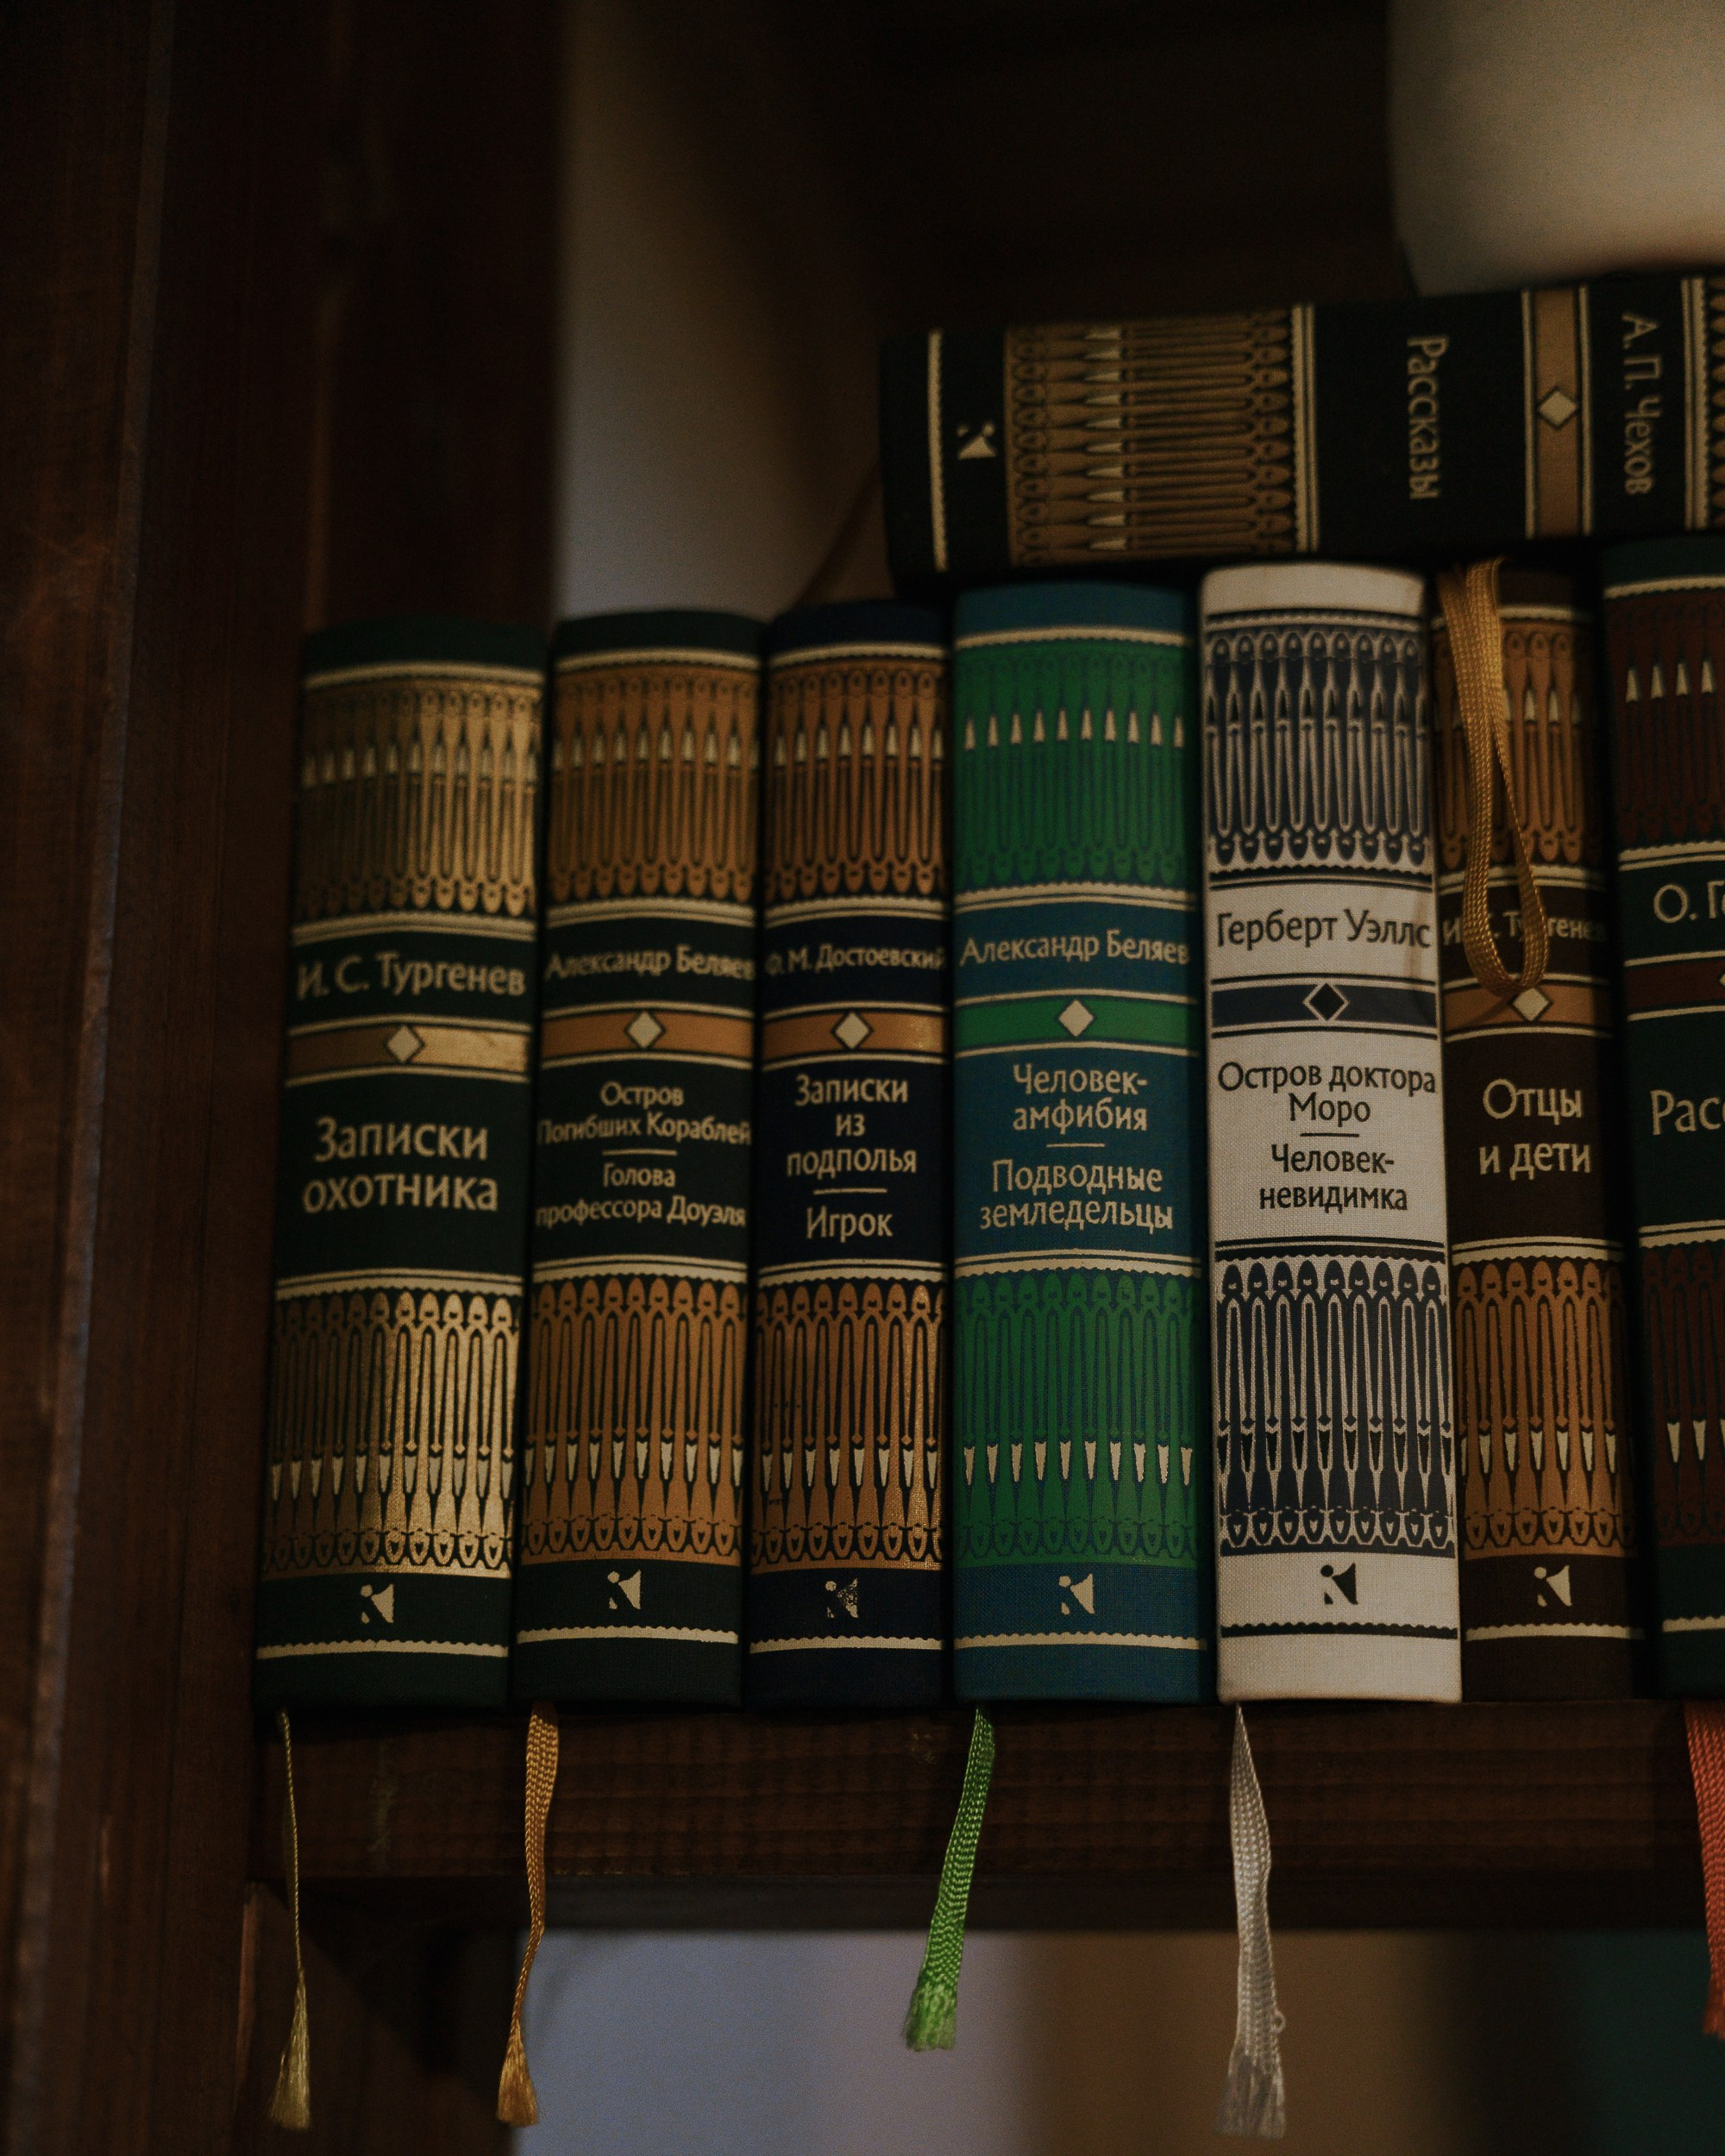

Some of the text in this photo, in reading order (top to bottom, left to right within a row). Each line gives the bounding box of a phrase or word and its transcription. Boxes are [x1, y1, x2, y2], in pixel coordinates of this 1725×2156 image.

[1406, 334, 1450, 500] Рассказы
[1622, 311, 1663, 496] А. П. Чехов
[1653, 881, 1725, 923] О. Г
[1217, 908, 1432, 950] Герберт Уэллс
[543, 943, 756, 981] Александр Беляев
[814, 943, 946, 974] Достоевский
[959, 929, 1191, 968] Александр Беляев
[297, 950, 527, 1000] И. С. Тургенев
[599, 1081, 684, 1109] Остров
[794, 1073, 909, 1107] Записки
[1013, 1063, 1149, 1096] Человек-
[1217, 1062, 1436, 1094] Остров доктора
[1013, 1097, 1148, 1134] амфибия
[1289, 1092, 1371, 1127] Моро
[1482, 1077, 1583, 1125] Отцы
[1649, 1089, 1725, 1136] Рас
[313, 1115, 488, 1163] Записки
[536, 1111, 751, 1146] Погибших Кораблей
[835, 1112, 866, 1138] из
[602, 1163, 675, 1188] Голова
[786, 1147, 918, 1180] подполья
[992, 1158, 1164, 1196] Подводные
[1270, 1143, 1396, 1175] Человек-
[1479, 1143, 1592, 1181] и дети
[301, 1173, 499, 1213] охотника
[1259, 1181, 1408, 1211] невидимка
[535, 1194, 747, 1230] профессора Доуэля
[806, 1206, 894, 1243] Игрок
[980, 1199, 1174, 1234] земледельцы
